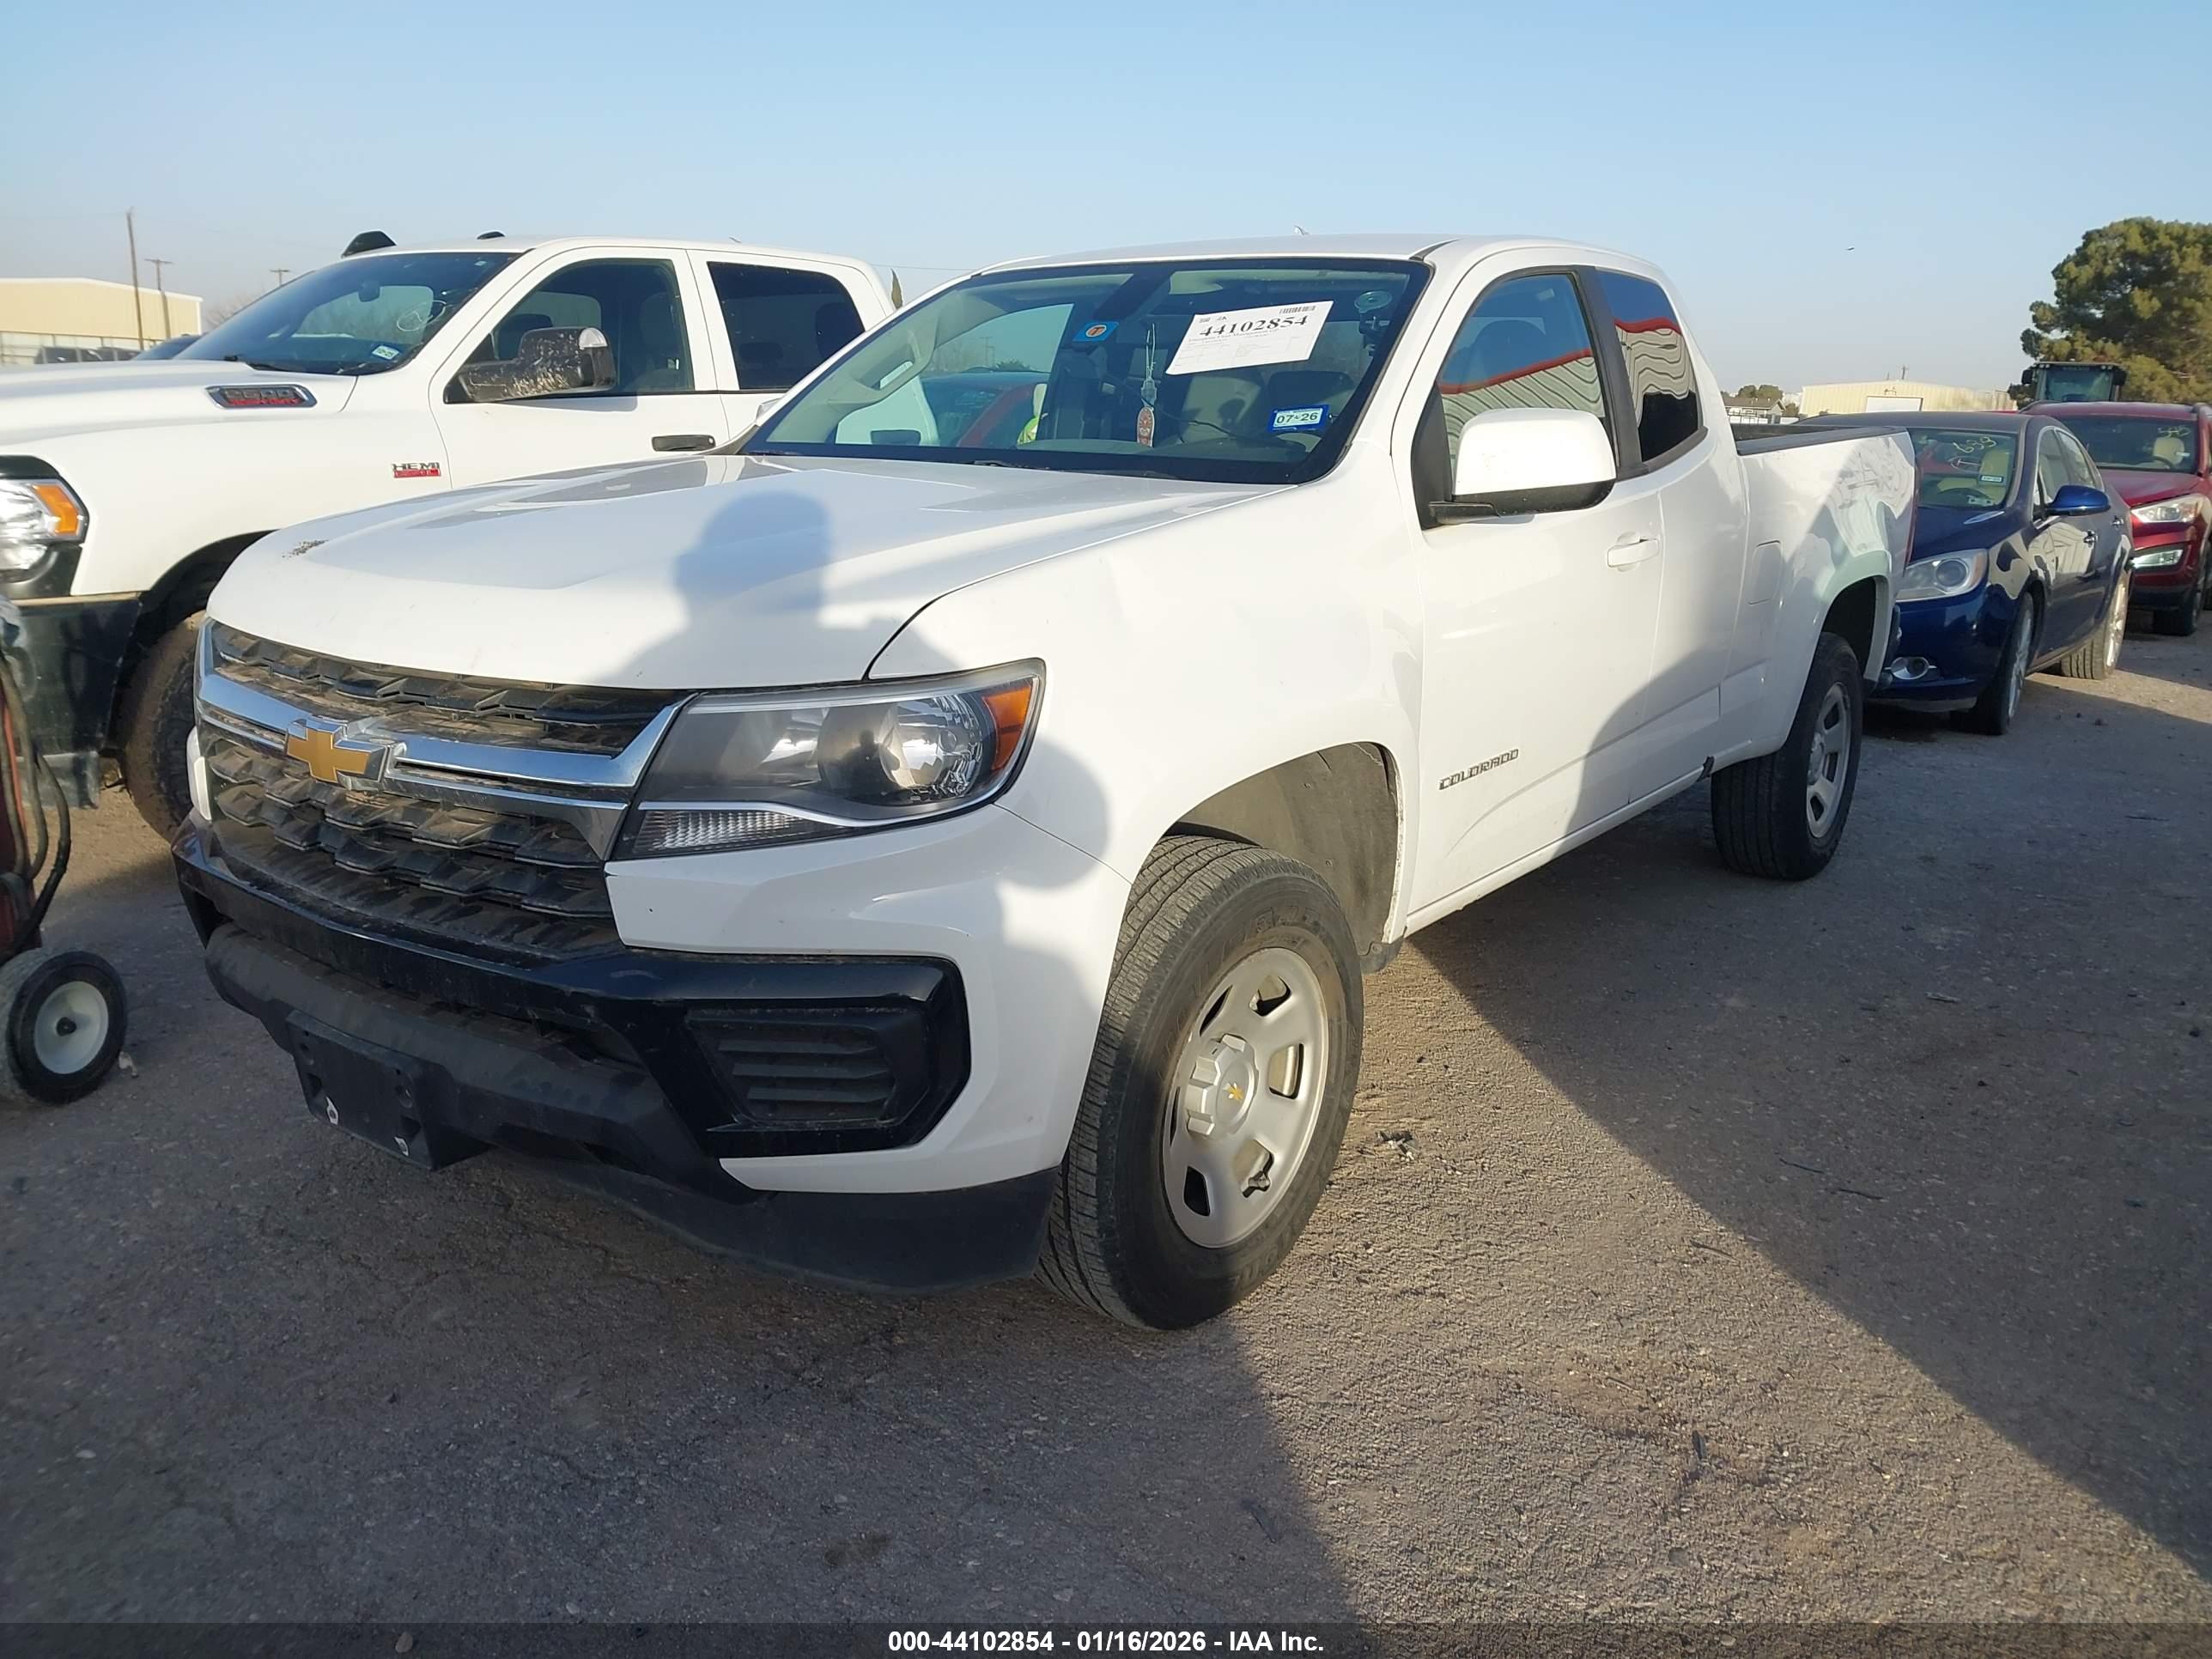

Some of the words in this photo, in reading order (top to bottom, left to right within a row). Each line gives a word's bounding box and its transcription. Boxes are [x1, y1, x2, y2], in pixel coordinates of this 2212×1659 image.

[1200, 315, 1309, 336] 44102854
[1276, 415, 1294, 424] 07
[1300, 412, 1319, 422] 26
[1438, 749, 1519, 790] COLORADO
